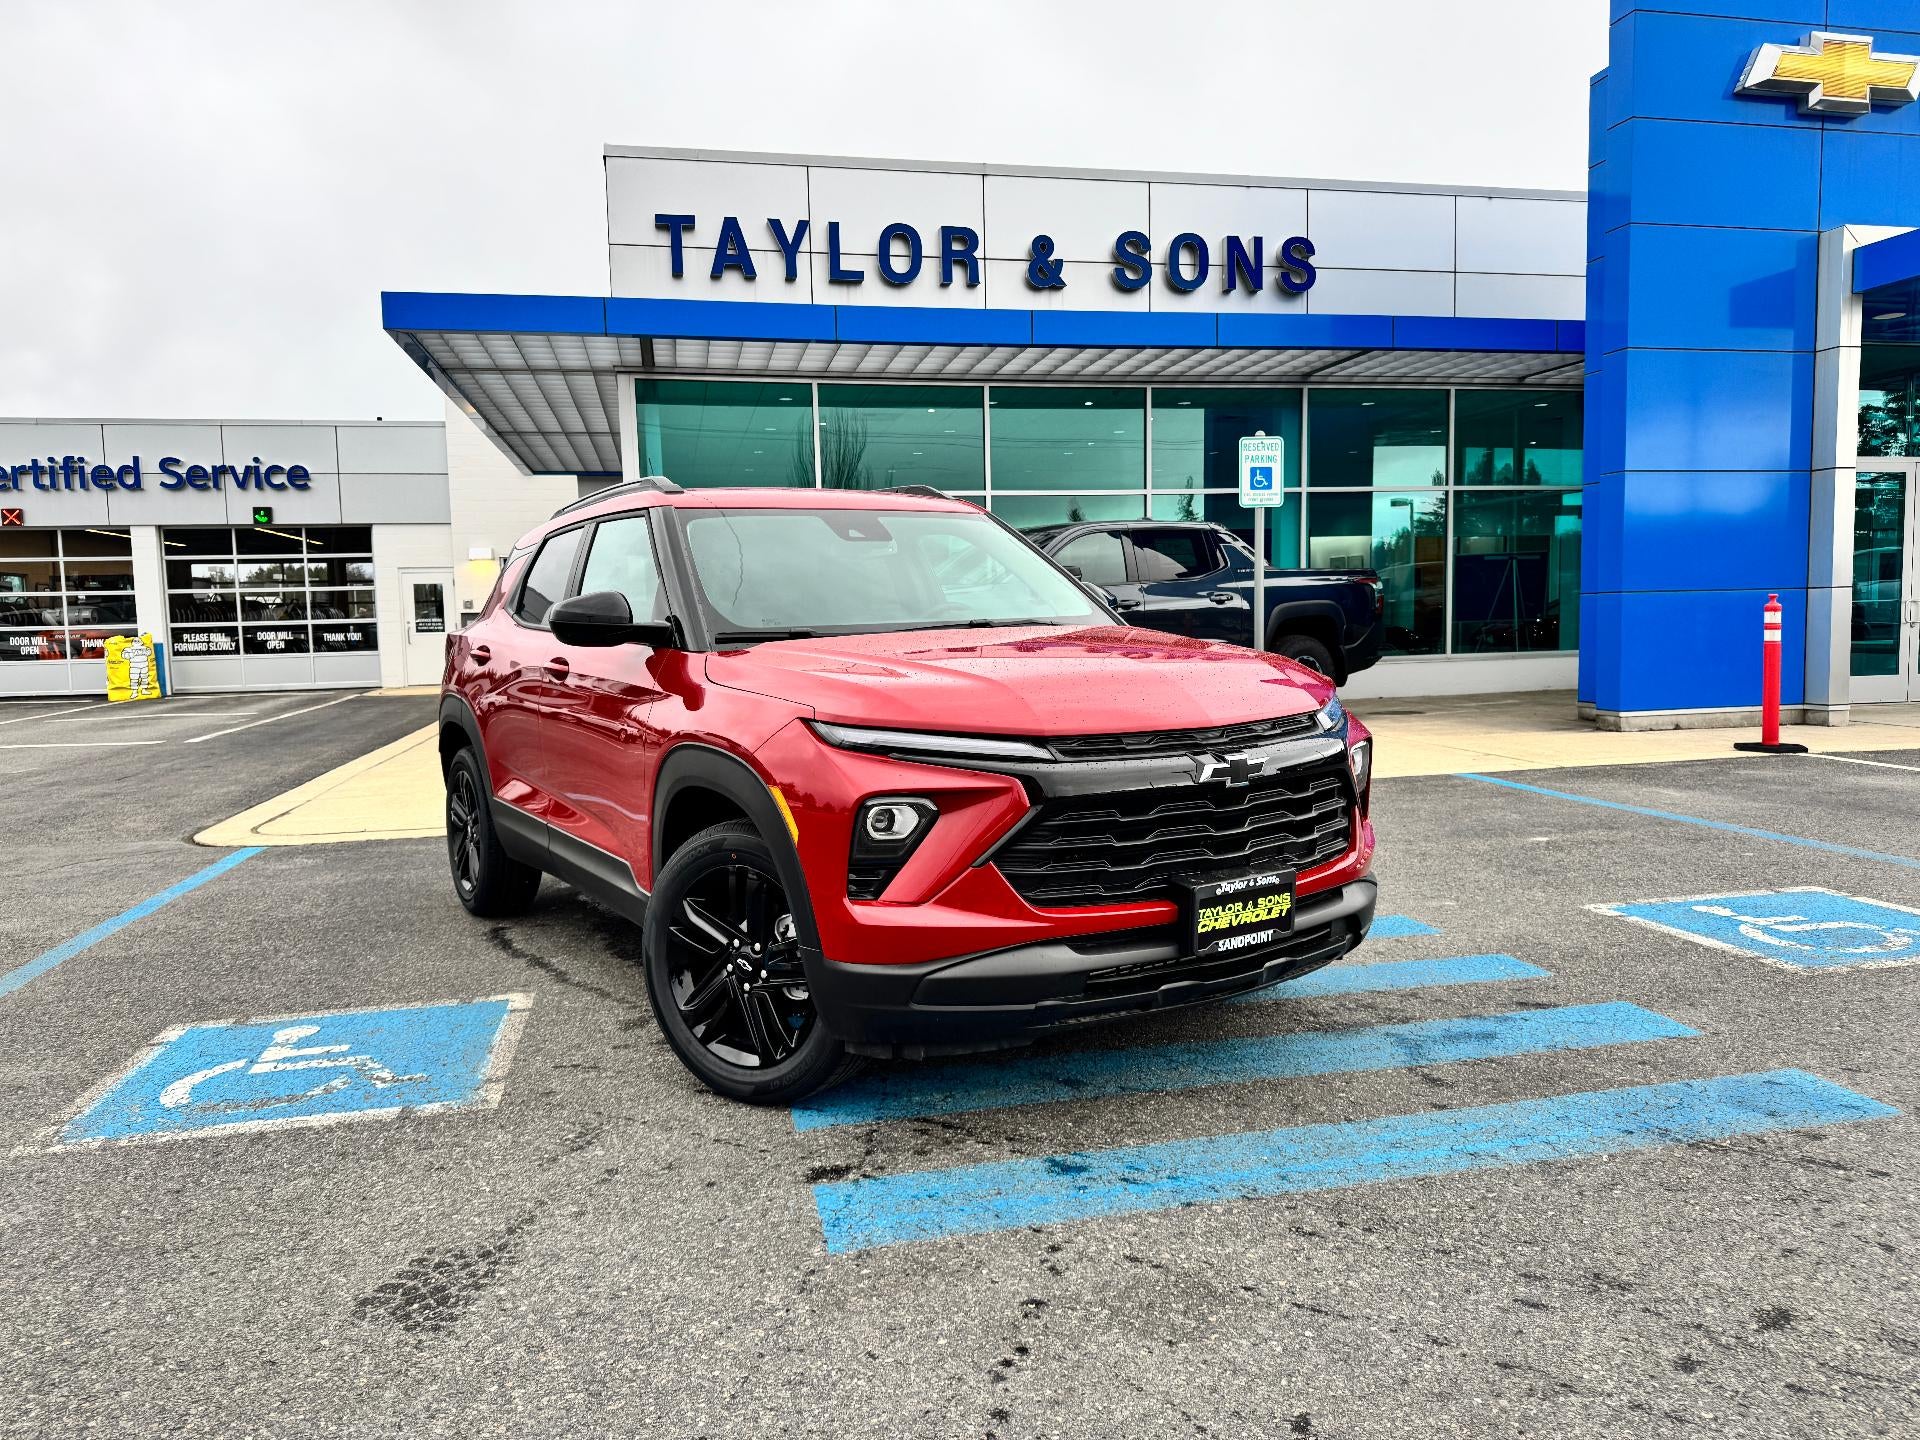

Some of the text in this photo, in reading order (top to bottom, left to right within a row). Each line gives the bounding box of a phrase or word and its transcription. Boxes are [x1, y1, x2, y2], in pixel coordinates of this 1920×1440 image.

[654, 213, 1318, 295] TAYLOR & SONS
[1243, 442, 1280, 452] RESERVED
[1244, 454, 1279, 464] PARKING
[0, 455, 312, 491] ertified Service
[9, 637, 31, 646] DOOR
[31, 636, 49, 646] WILL
[183, 632, 227, 643] PLEASE PULL
[257, 631, 294, 641] DOOR WILL
[323, 632, 362, 642] THANK YOU!
[80, 639, 105, 648] THANK
[174, 641, 236, 652] FORWARD SLOWLY
[267, 641, 285, 650] OPEN
[20, 646, 40, 655] OPEN
[1220, 880, 1248, 894] Taylor
[1256, 875, 1276, 886] Sons
[1198, 892, 1291, 920] TAYLOR & SONS
[1197, 903, 1291, 934] CHEVROLET
[1217, 929, 1274, 952] SANDPOINT
